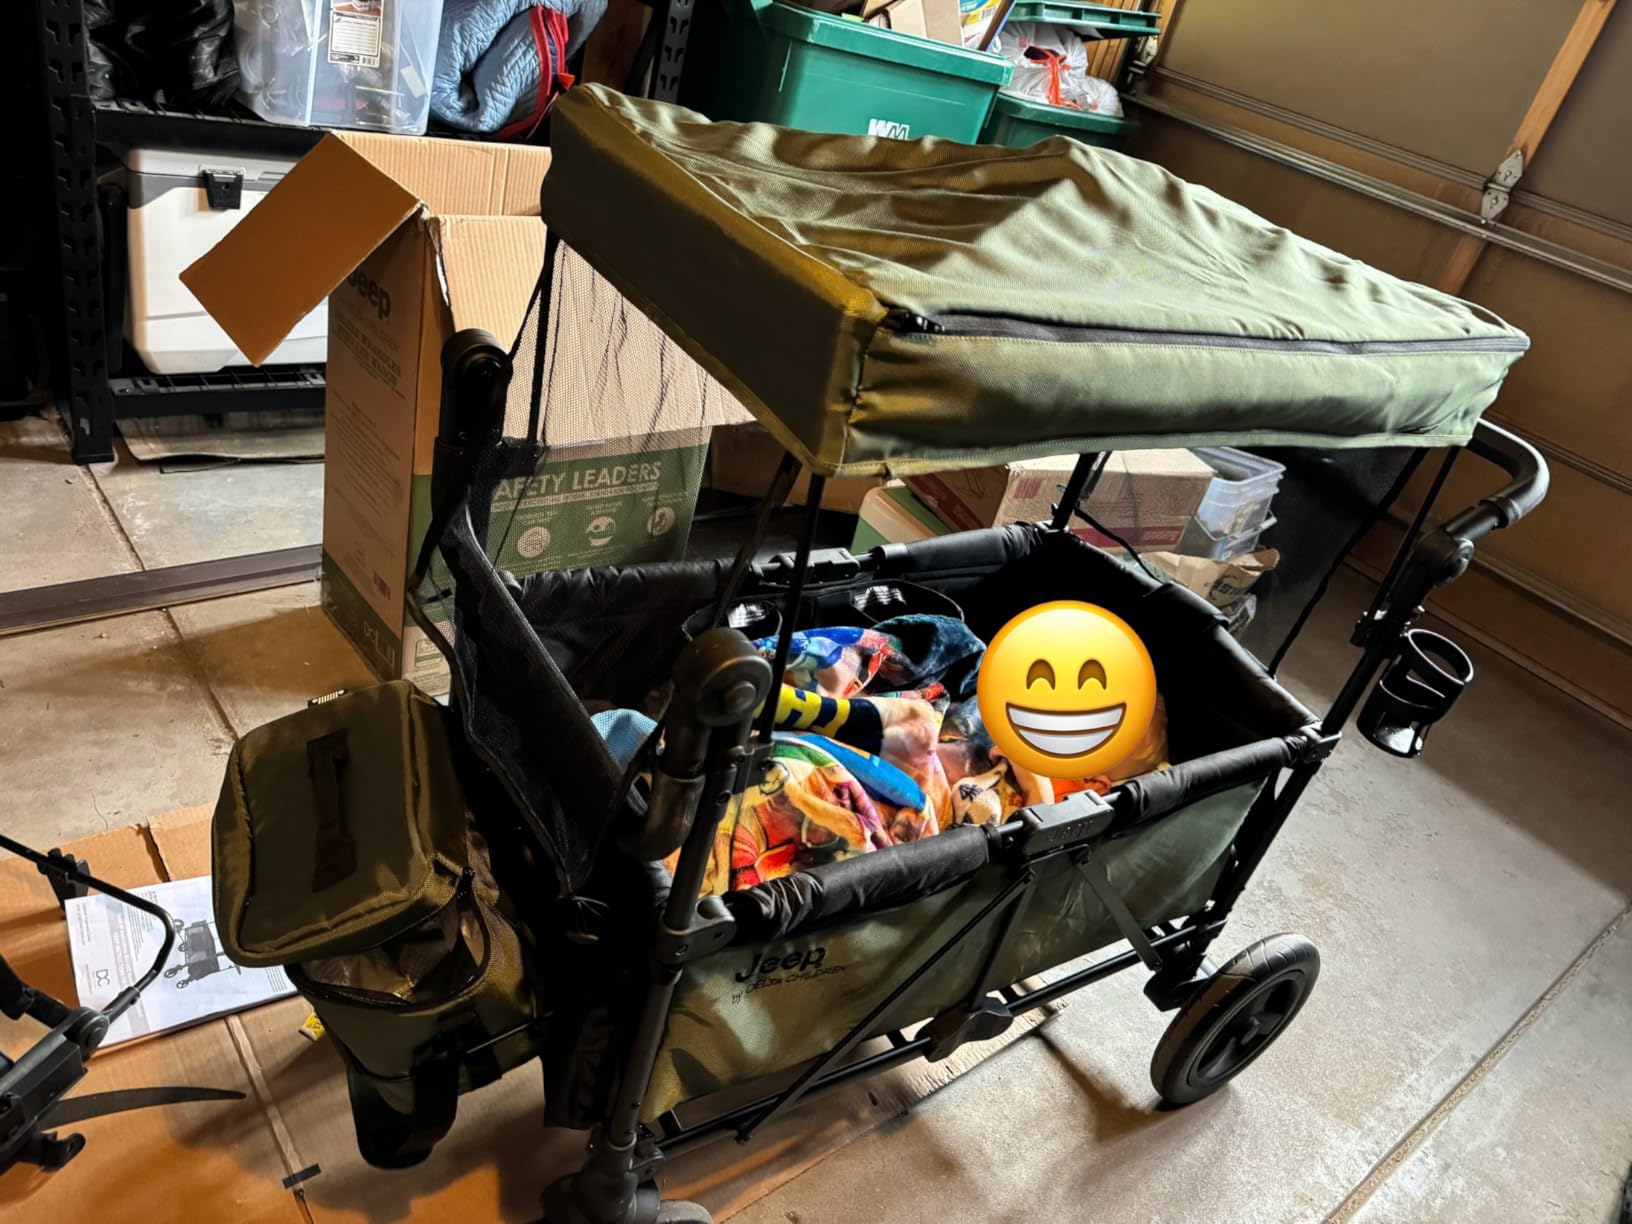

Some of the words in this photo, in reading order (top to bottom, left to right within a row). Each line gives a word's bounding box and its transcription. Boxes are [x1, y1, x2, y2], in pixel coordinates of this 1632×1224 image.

[868, 118, 910, 141] WM
[494, 472, 566, 500] AFETY
[572, 461, 662, 490] LEADERS
[96, 969, 110, 987] DC
[735, 947, 826, 983] Jeep
